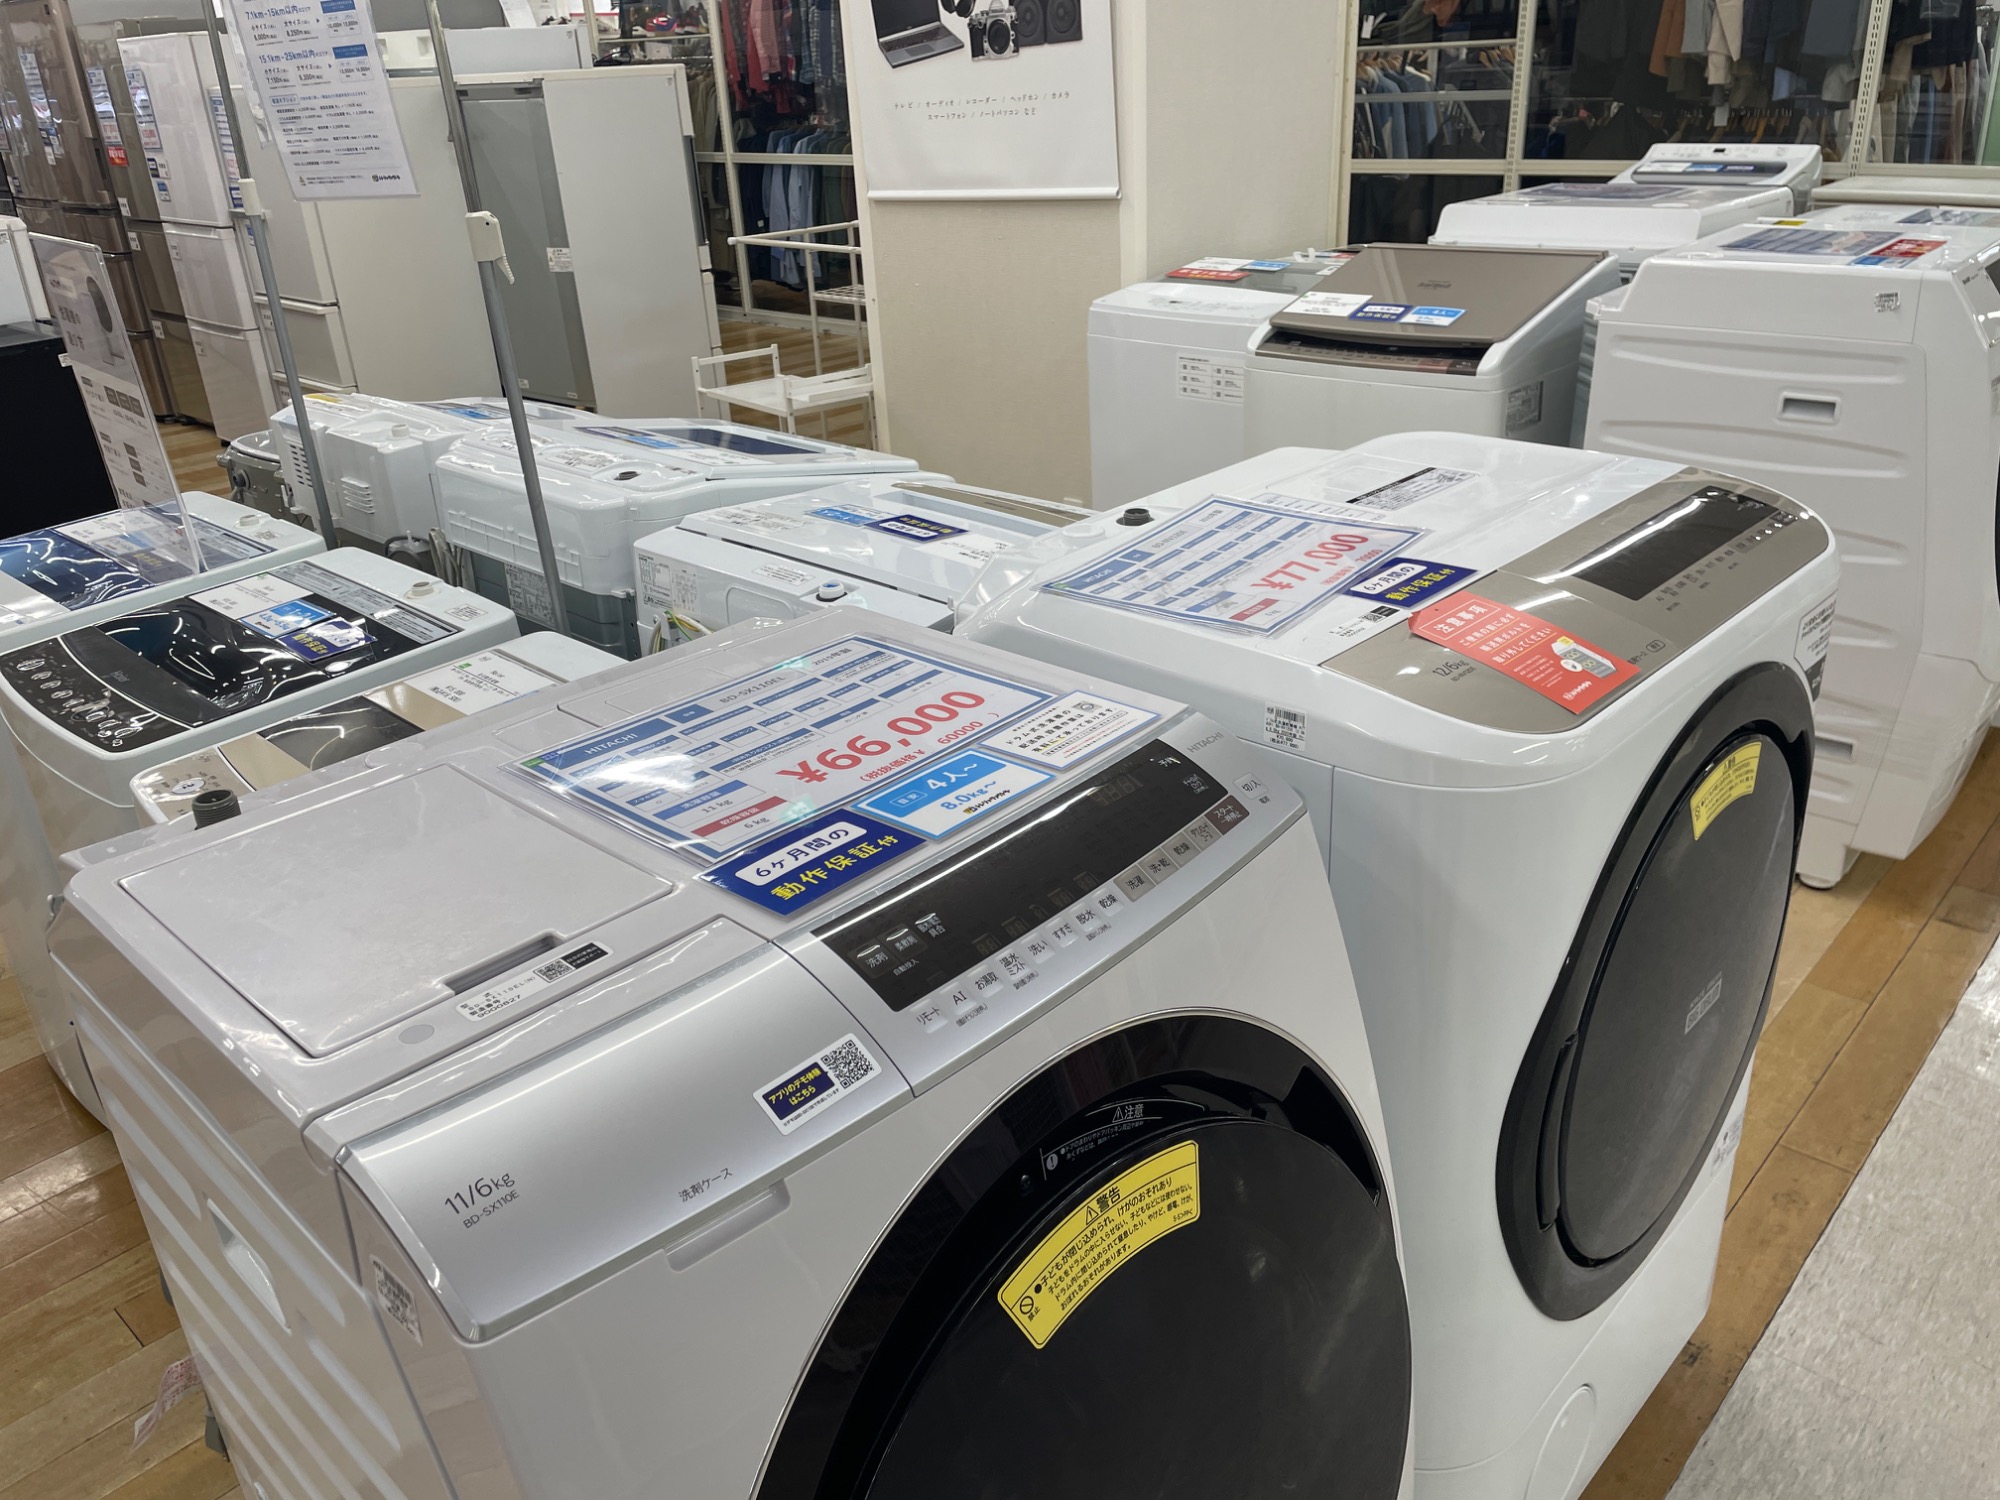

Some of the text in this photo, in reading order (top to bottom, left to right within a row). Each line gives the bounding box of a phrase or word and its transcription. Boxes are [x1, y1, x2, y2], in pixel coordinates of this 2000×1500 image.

[894, 102, 913, 110] テレビ
[925, 99, 954, 108] オーディオ
[966, 97, 997, 106] レコーダー
[1051, 91, 1070, 100] カメラ
[928, 112, 967, 121] スマートフォン
[979, 108, 1019, 118] ノートパソコン
[1250, 533, 1369, 590] ¥77,000
[1385, 568, 1456, 601] 動作保証付
[1433, 604, 1488, 634] 注意事項
[1459, 612, 1516, 646] ご使用の前に必ず
[1480, 622, 1531, 652] 輸送用ボルトを
[1492, 627, 1552, 664] 取り外してください
[776, 691, 985, 784] ¥66,000
[937, 720, 983, 745] 60000
[1006, 709, 1071, 745] ドラム式洗濯機の
[584, 732, 639, 756] HITACHI
[1187, 732, 1225, 754] HITACHI
[1241, 778, 1262, 792] 切/入
[701, 798, 734, 814] 11 kg
[1213, 804, 1234, 819] スタート
[755, 816, 770, 827] kg
[771, 834, 899, 901] 動作保証付
[1125, 875, 1146, 891] 洗濯
[1098, 893, 1118, 910] 乾燥
[1075, 909, 1096, 925] 脱水
[1052, 924, 1073, 941] すすぎ
[1028, 939, 1049, 957] 洗い
[865, 951, 889, 970] 洗剤
[893, 958, 920, 977] 自動投入
[999, 952, 1019, 968] 温水
[1007, 961, 1026, 977] ミスト
[974, 972, 999, 991] お湯取
[476, 994, 521, 1019] 9000827
[952, 990, 968, 1005] AI
[916, 1005, 941, 1026] リモート
[768, 1067, 822, 1104] アプリのデモ体験
[788, 1085, 816, 1106] はこちら
[1124, 1103, 1144, 1120] 注意
[444, 1172, 515, 1215] 11/6kg
[678, 1167, 734, 1203] 洗剤ケース
[462, 1189, 520, 1230] BD-SX110E
[1097, 1185, 1121, 1214] 警告
